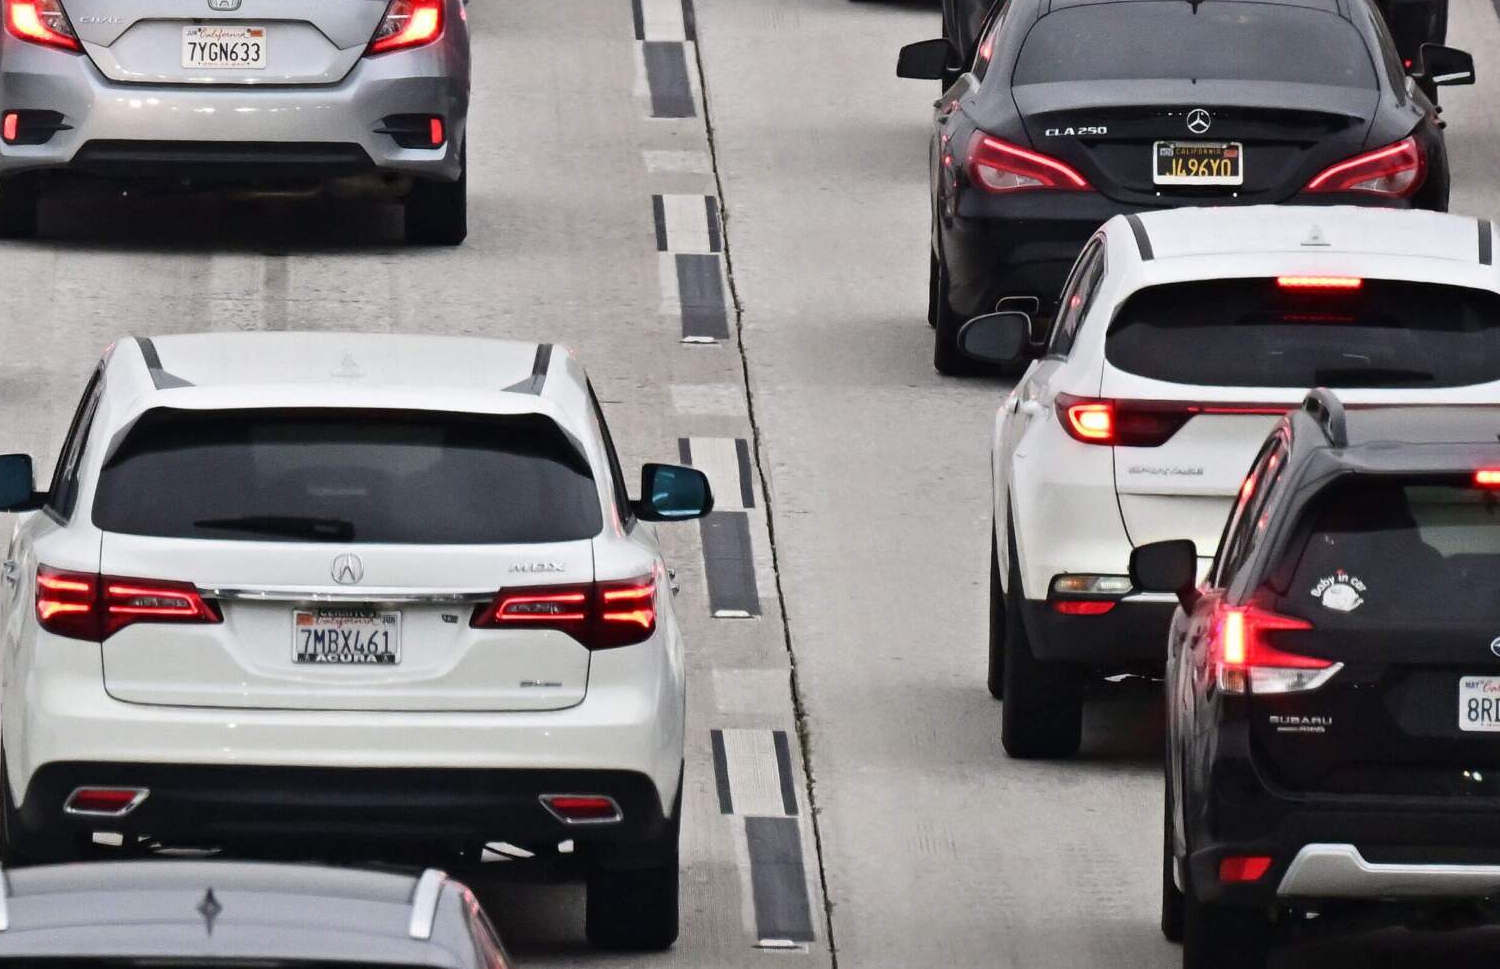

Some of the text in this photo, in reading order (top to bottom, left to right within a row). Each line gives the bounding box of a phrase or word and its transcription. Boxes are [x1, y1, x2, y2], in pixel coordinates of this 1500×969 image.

[79, 15, 125, 25] CIVIC
[199, 26, 247, 41] California
[187, 42, 261, 62] 7YGN633
[1045, 126, 1108, 137] CLA 250
[1311, 573, 1368, 598] Baby in car
[381, 615, 396, 625] JUN
[301, 629, 391, 654] 7MBX461
[315, 653, 378, 663] ACURA
[1270, 715, 1332, 725] SUBARU
